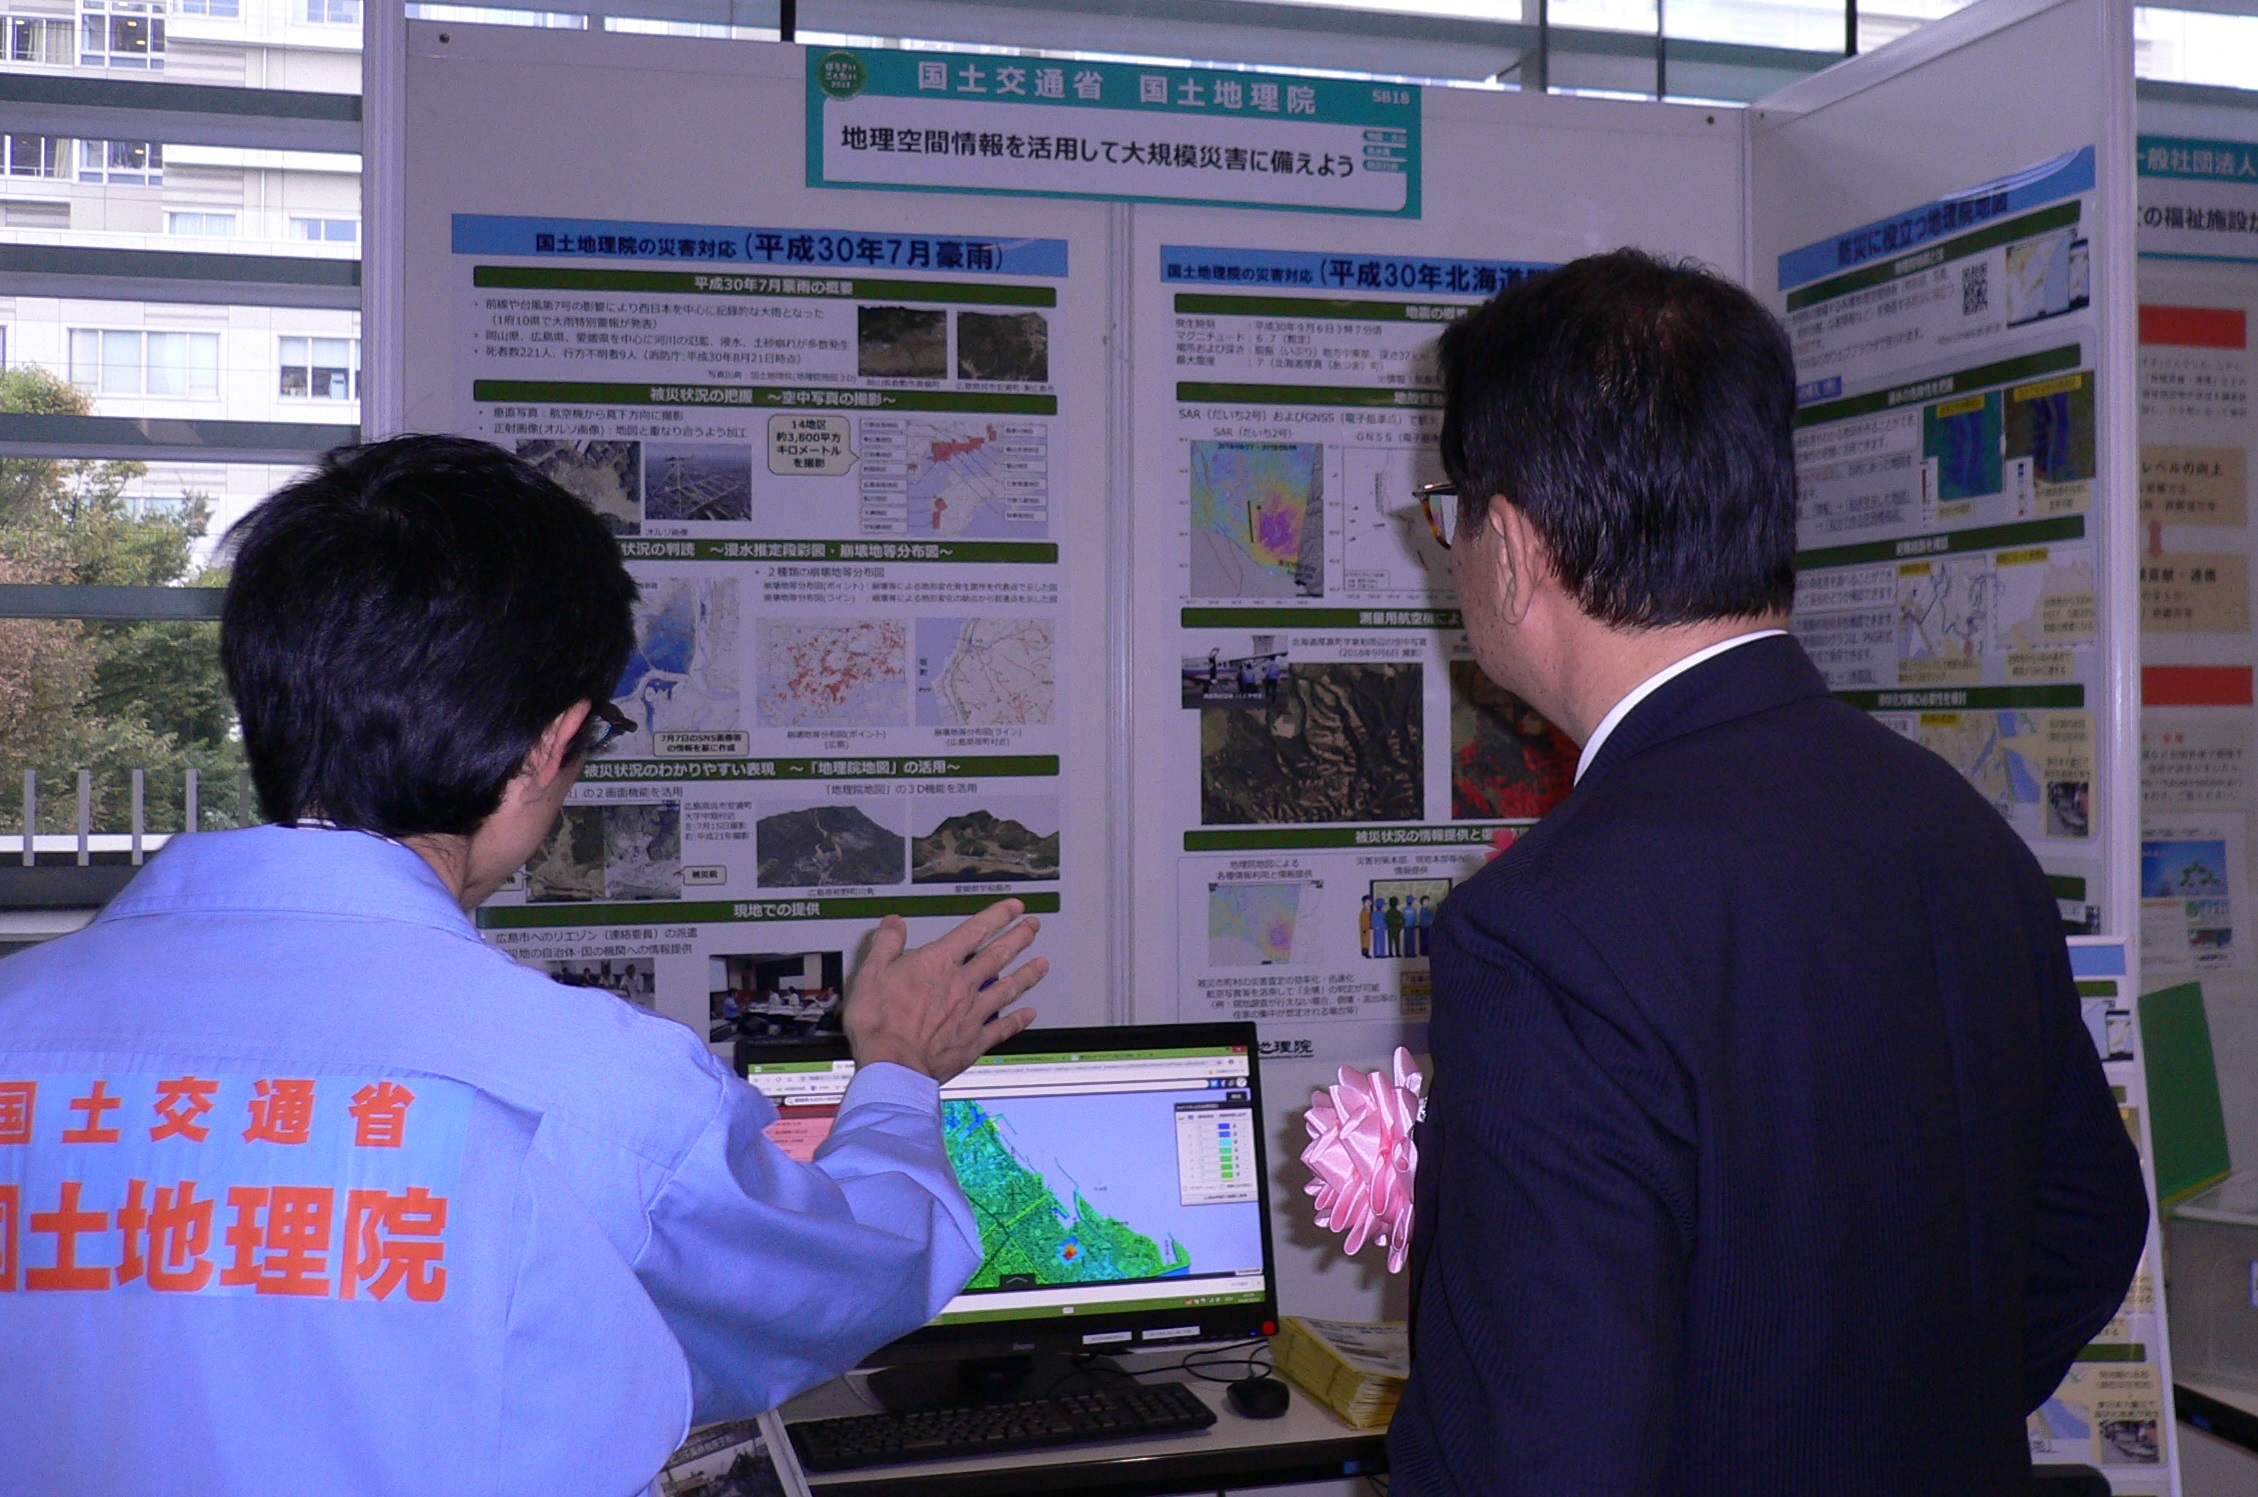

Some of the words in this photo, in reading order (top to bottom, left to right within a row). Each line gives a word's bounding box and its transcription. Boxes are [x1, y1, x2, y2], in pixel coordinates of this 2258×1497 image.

[917, 60, 1103, 101] 国土交通省
[1139, 75, 1317, 115] 国土地理院
[841, 125, 1355, 179] 地理空間情報を活用して大規模災害に備えよう
[2137, 205, 2258, 234] の福祉施設
[694, 275, 853, 296] 平成30年7月豪雨の概要
[1176, 331, 1246, 344] マグニチュード
[650, 387, 753, 404] 被災状況の把握
[790, 418, 827, 430] 14地区
[777, 445, 842, 457] キロメートル
[793, 457, 826, 468] を撮影
[620, 543, 696, 557] 状況の判読
[1356, 825, 1530, 845] 被災状況の情報提供と復
[733, 902, 821, 918] 現地での提供
[0, 1076, 416, 1148] 国土交通省
[0, 1178, 449, 1303] 土地理院
